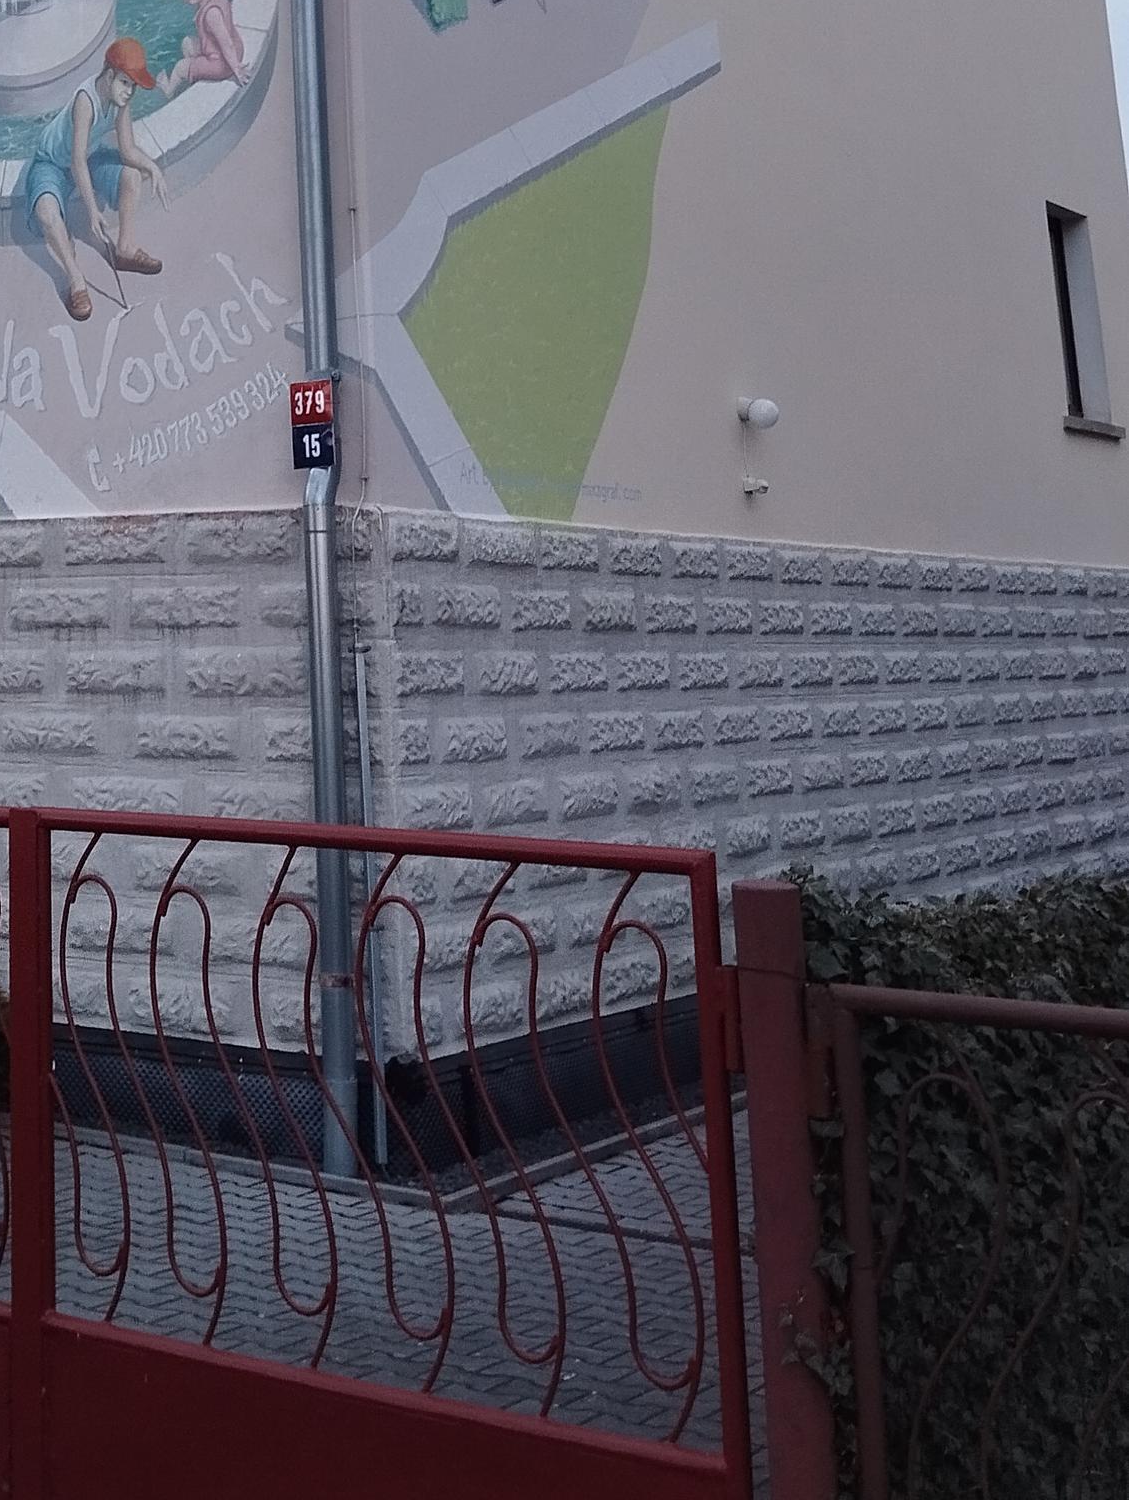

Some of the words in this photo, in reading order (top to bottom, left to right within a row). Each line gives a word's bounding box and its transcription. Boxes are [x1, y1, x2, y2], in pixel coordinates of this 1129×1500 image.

[48, 251, 291, 420] Vodach
[294, 389, 325, 416] 379
[302, 432, 321, 458] 15
